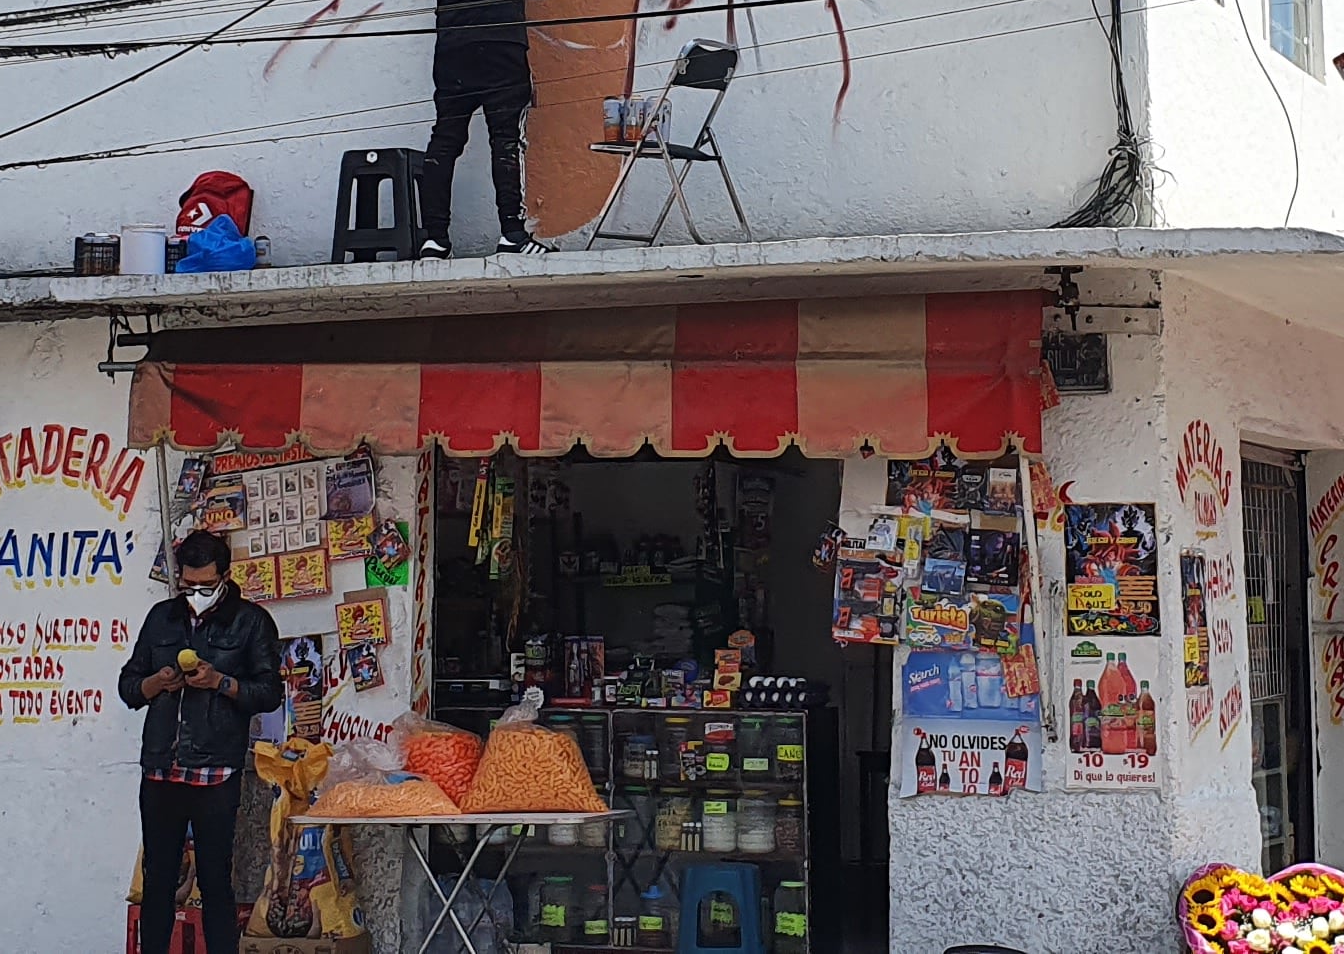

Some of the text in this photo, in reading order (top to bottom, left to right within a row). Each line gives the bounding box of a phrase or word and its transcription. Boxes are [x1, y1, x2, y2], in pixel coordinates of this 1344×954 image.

[1176, 419, 1232, 507] MATERIAS
[912, 604, 969, 631] Turista
[34, 613, 100, 651] SURTIDO
[111, 618, 129, 643] EN
[9, 689, 43, 716] TODO
[50, 688, 102, 715] EVENTO
[929, 734, 1007, 750] NO OLVIDES
[942, 750, 955, 762] TU
[958, 751, 981, 767] AN
[1078, 753, 1149, 769] $10 $19
[958, 768, 980, 784] TO
[1006, 764, 1025, 780] Red
[1074, 770, 1083, 781] Di
[1086, 772, 1102, 784] que
